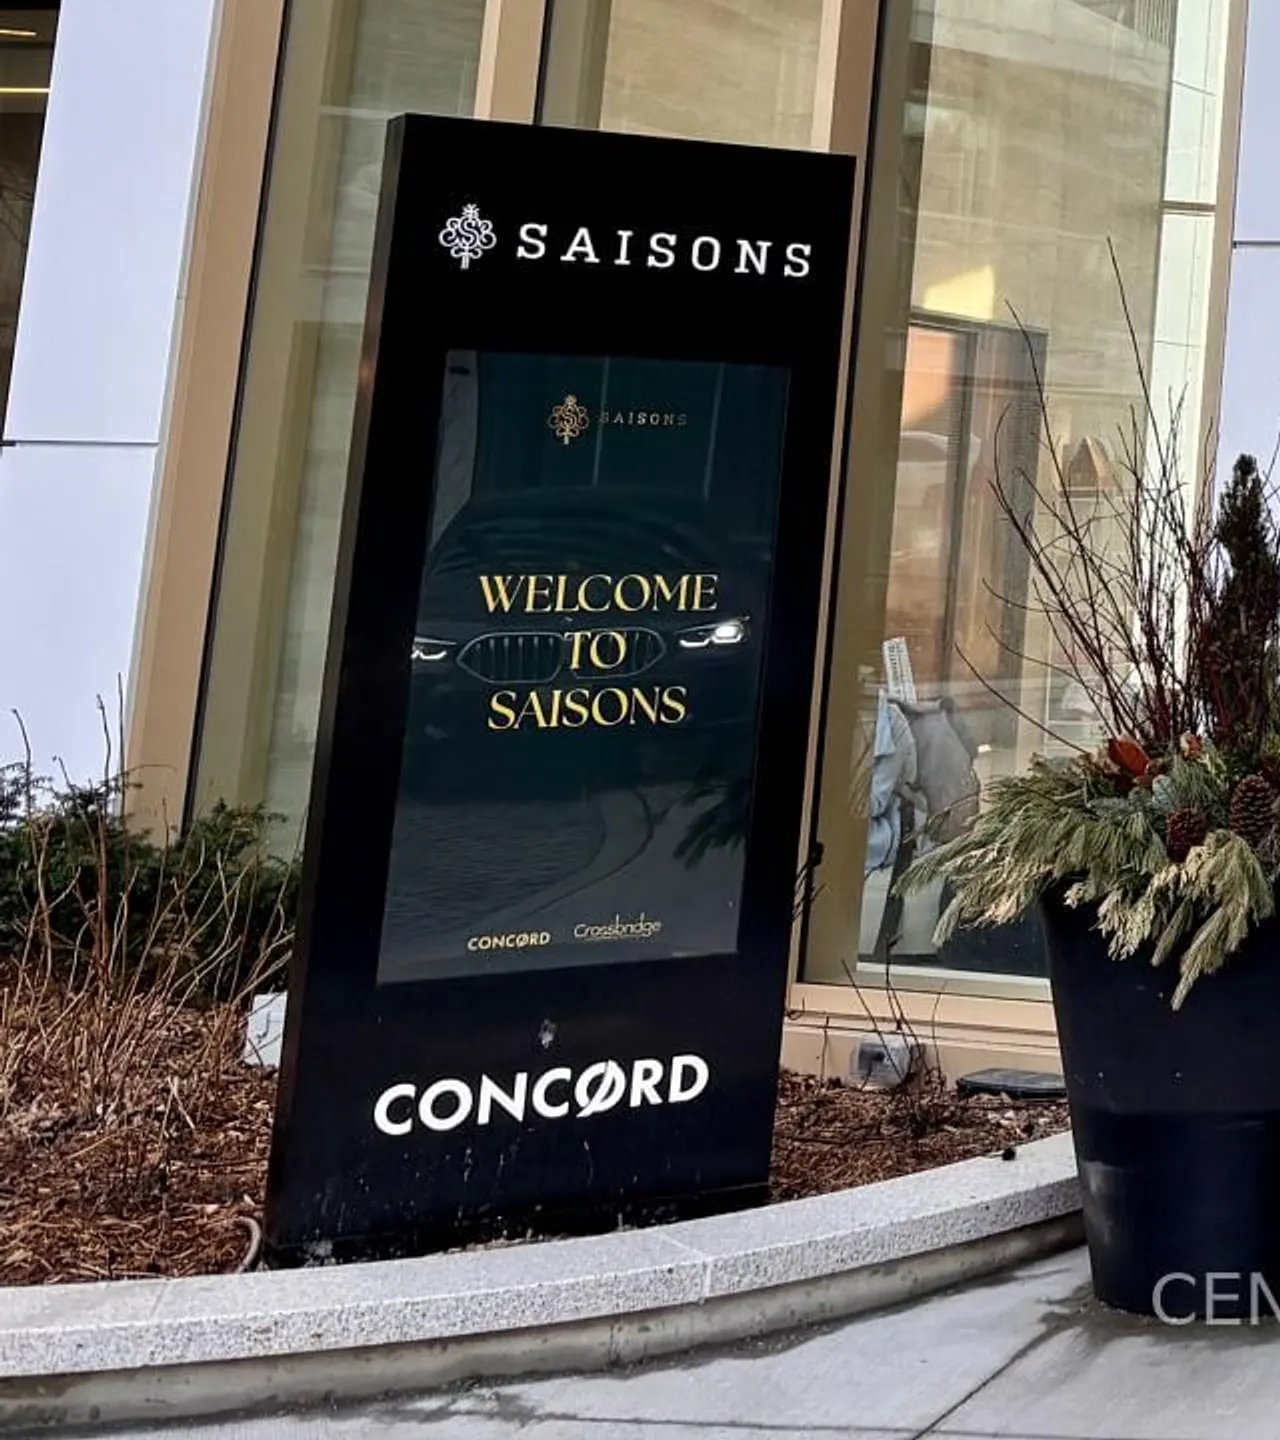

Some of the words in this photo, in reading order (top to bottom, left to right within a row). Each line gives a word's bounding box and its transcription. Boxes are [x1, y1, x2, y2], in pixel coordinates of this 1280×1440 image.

[517, 223, 812, 277] SAISONS
[600, 411, 687, 426] SAISONS
[479, 574, 719, 613] WELCOME
[564, 630, 627, 669] TO
[487, 686, 686, 730] SAISONS
[573, 913, 662, 939] Crossbridge
